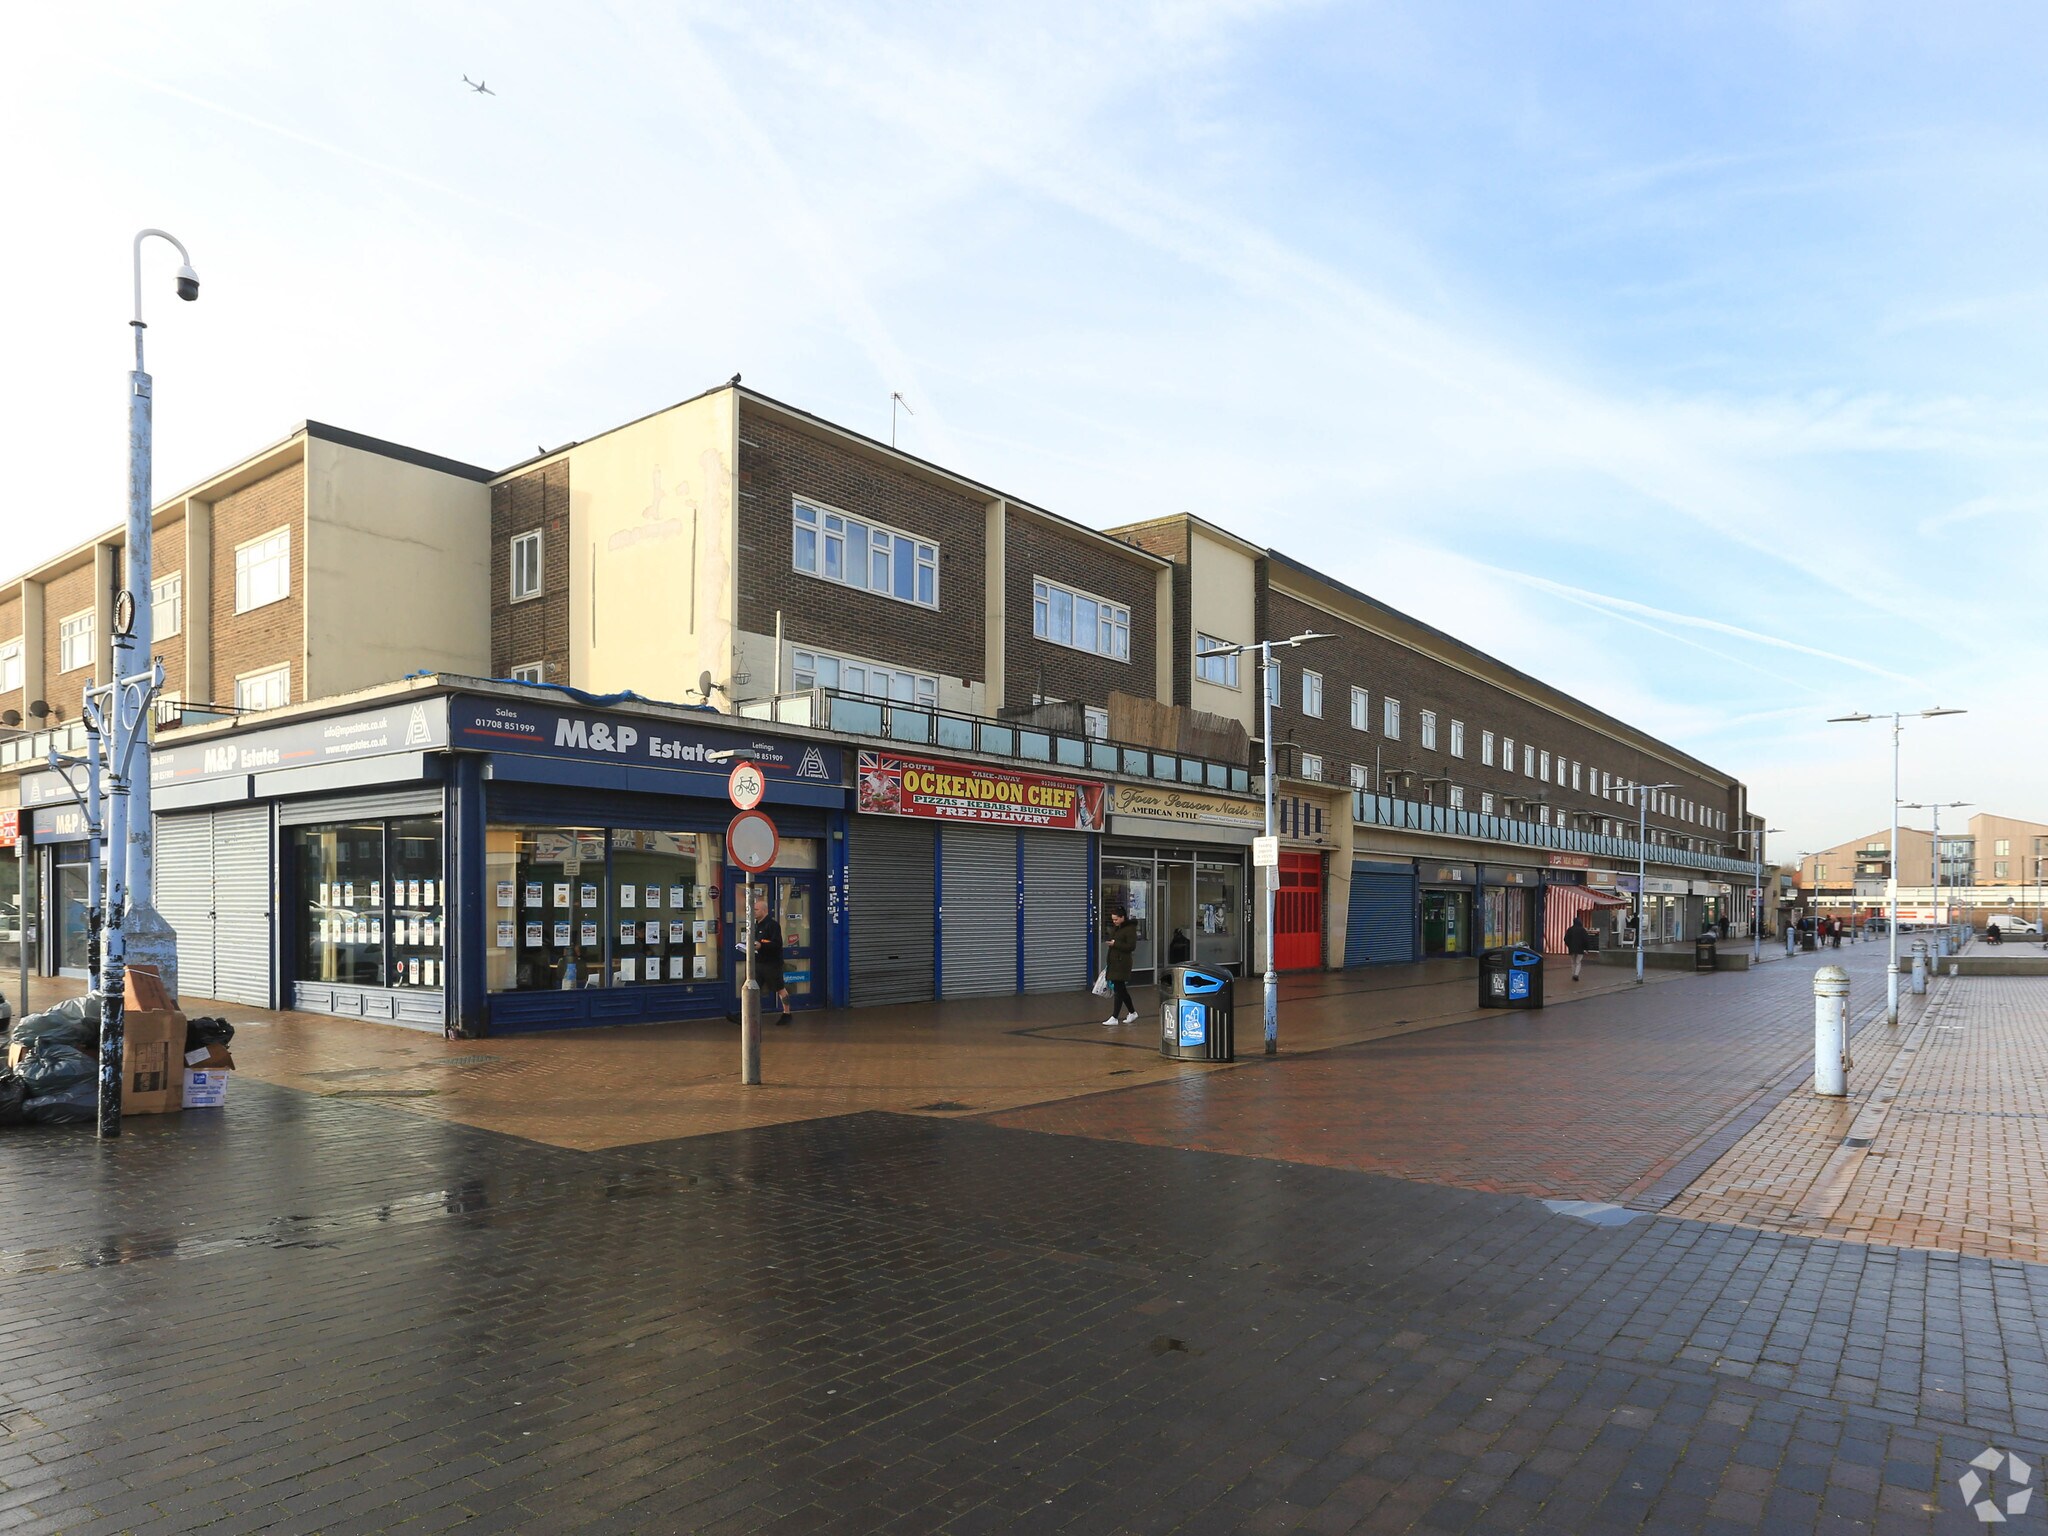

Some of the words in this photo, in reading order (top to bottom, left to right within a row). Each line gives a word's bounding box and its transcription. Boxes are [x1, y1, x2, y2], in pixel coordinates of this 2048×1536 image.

[495, 708, 517, 719] Sales
[475, 718, 502, 729] 01708
[504, 721, 535, 733] 851999
[554, 718, 638, 753] M&P
[752, 742, 775, 752] Lettings
[204, 745, 237, 774] M&P
[241, 747, 280, 768] Estates
[761, 754, 784, 763] 851909
[902, 762, 935, 771] SOUTH
[971, 770, 1021, 783] TAKE-AWAY
[903, 770, 1024, 803] OCKENDON
[1028, 785, 1075, 808] CHEF
[915, 795, 958, 806] PIZZAS
[967, 801, 1012, 811] KEBABS
[1020, 806, 1067, 817] BURGERS
[1116, 788, 1160, 813] Four
[1164, 793, 1213, 811] Season
[1216, 802, 1250, 816] Nails
[936, 806, 977, 818] FREE
[980, 810, 1051, 824] DELIVERY
[1131, 806, 1173, 817] AMERICAN
[1175, 810, 1198, 819] STYLE
[56, 813, 78, 835] M&P
